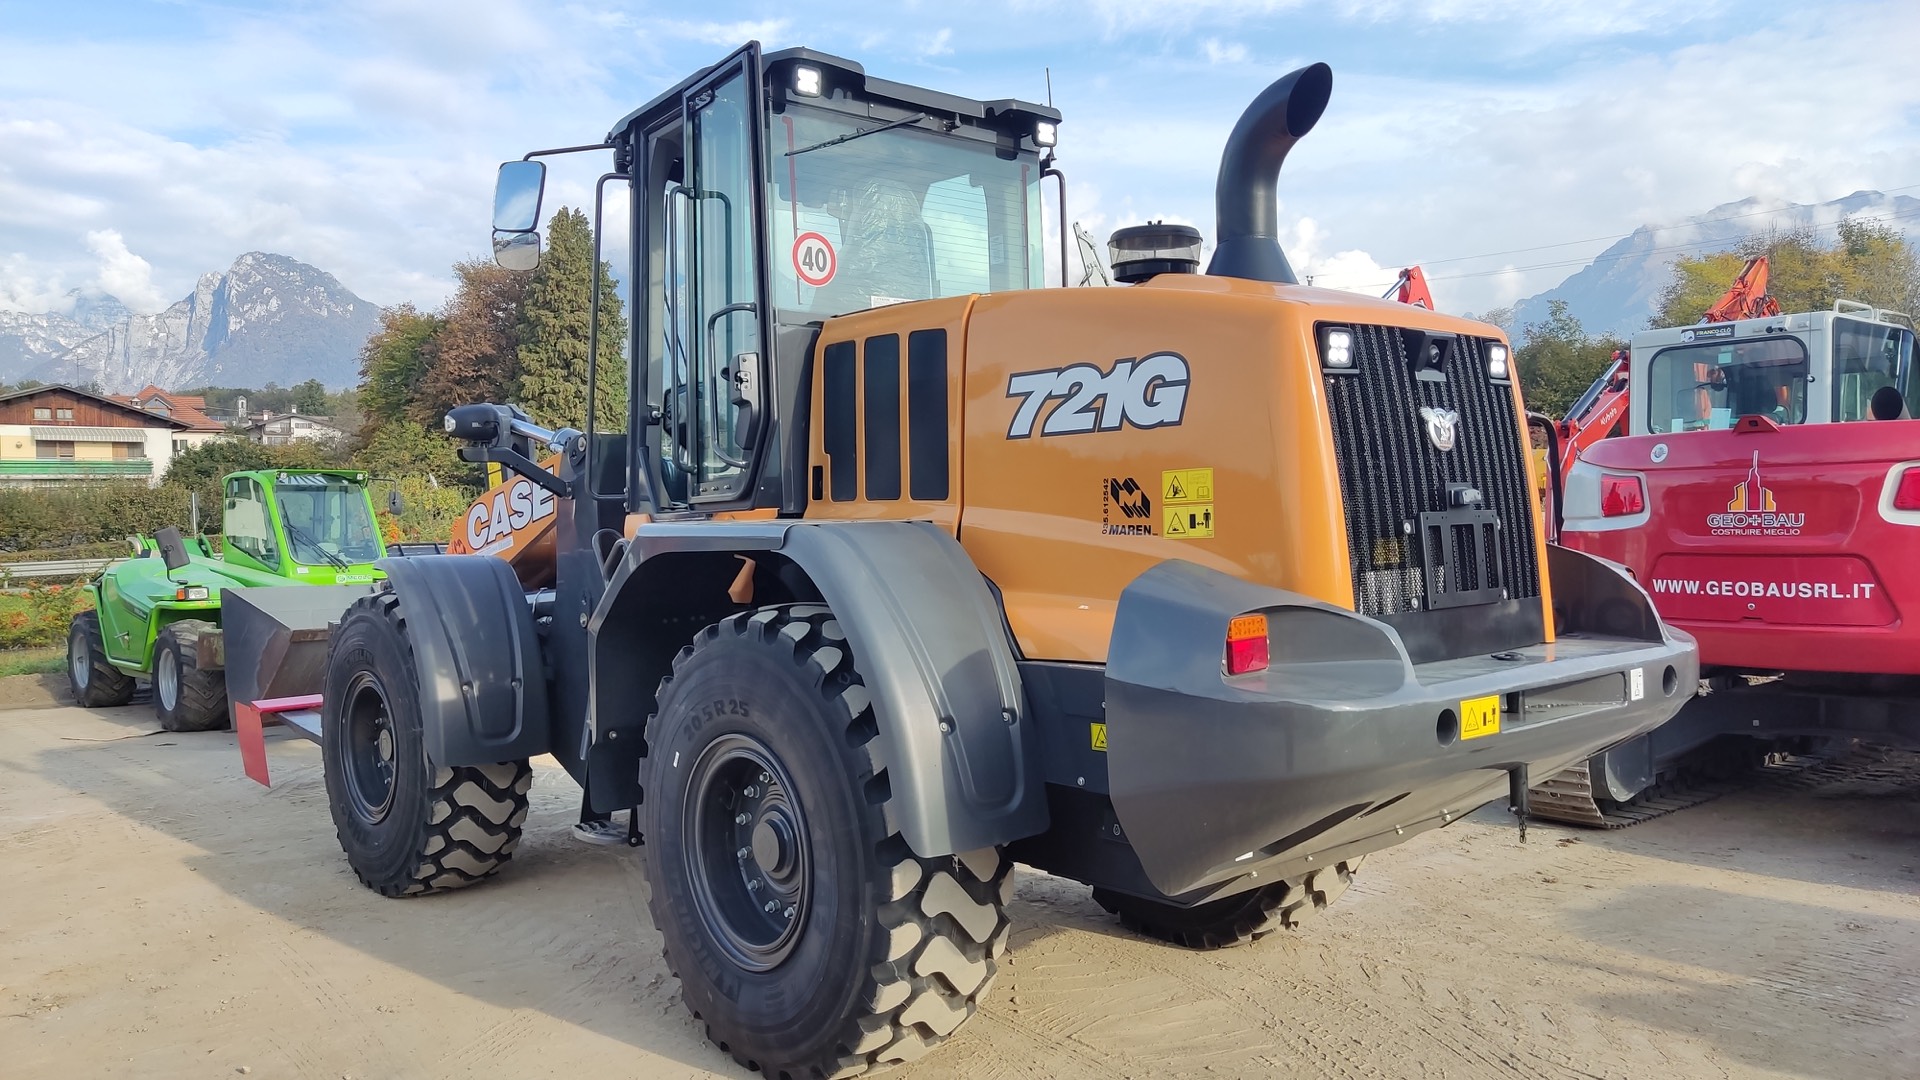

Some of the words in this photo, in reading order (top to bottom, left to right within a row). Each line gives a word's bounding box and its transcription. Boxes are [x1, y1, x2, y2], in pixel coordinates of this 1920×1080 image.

[802, 246, 828, 273] 40
[1006, 351, 1190, 440] 721G
[467, 464, 555, 550] CASE
[1109, 525, 1152, 536] MAREN
[1707, 513, 1805, 528] GEO+BAU
[1711, 528, 1761, 536] COSTRUIRE
[1763, 528, 1801, 536] MEGLIO
[1652, 578, 1875, 599] WWW.GEOBAUSRL.IT
